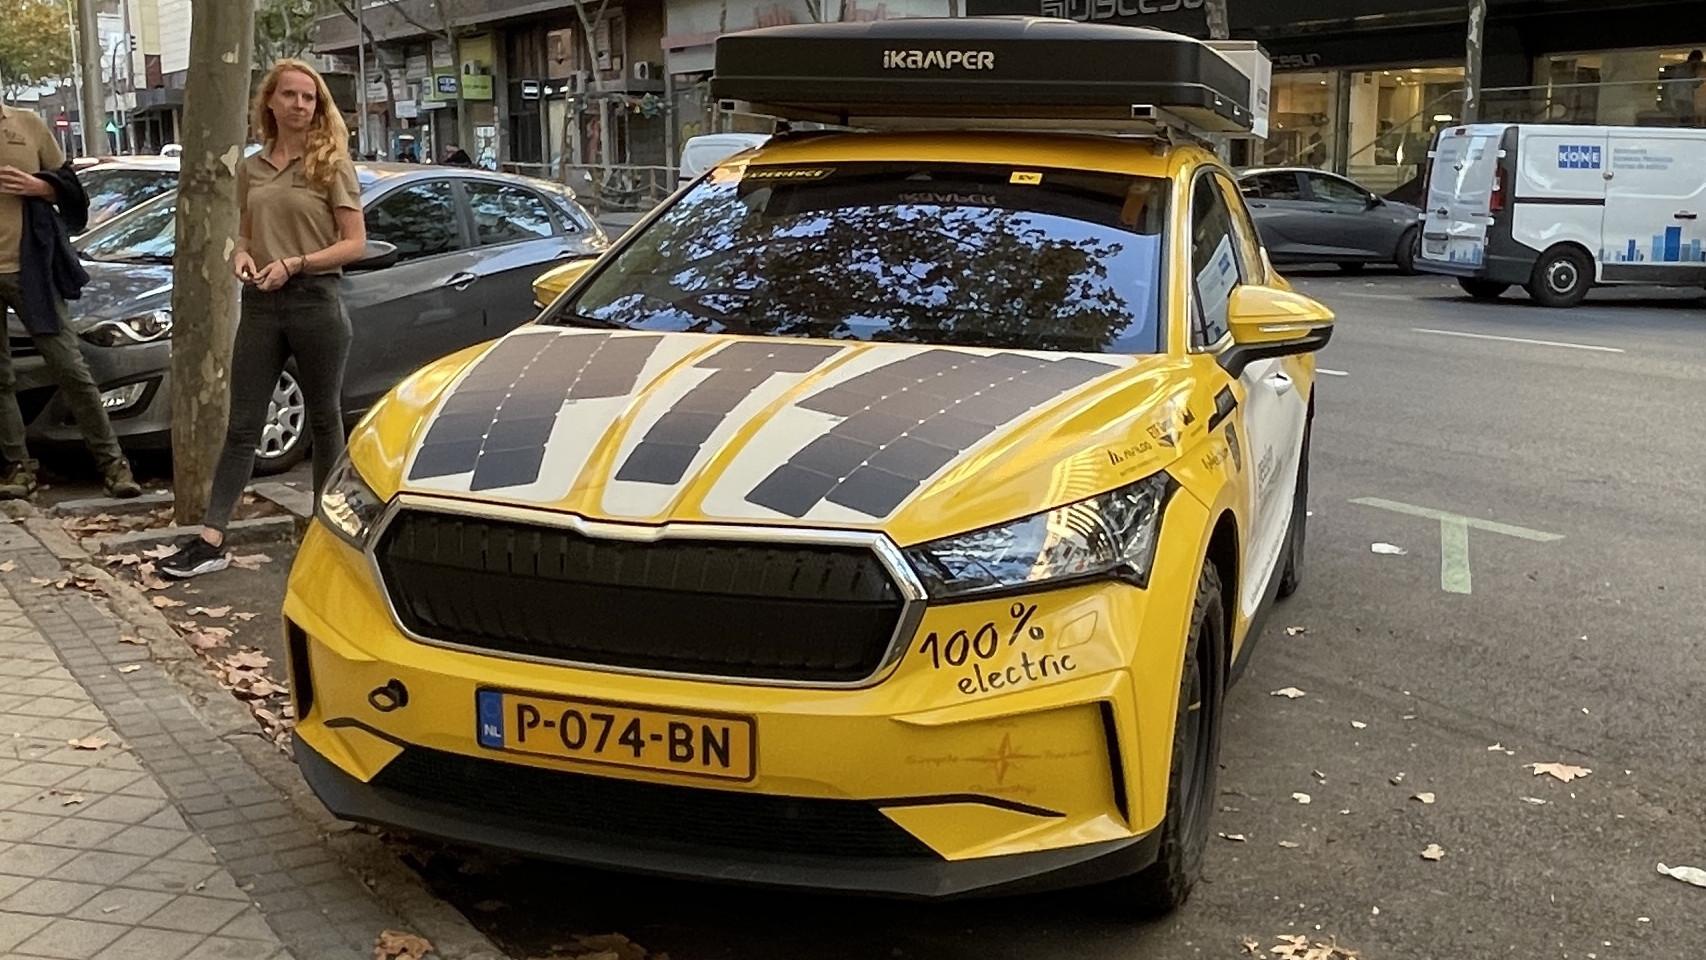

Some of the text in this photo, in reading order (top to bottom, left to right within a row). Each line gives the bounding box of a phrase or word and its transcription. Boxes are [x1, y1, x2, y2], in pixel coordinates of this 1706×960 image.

[1559, 152, 1600, 162] KONE
[957, 652, 1077, 695] electric
[484, 723, 502, 738] NL
[516, 703, 731, 768] P-074-BN
